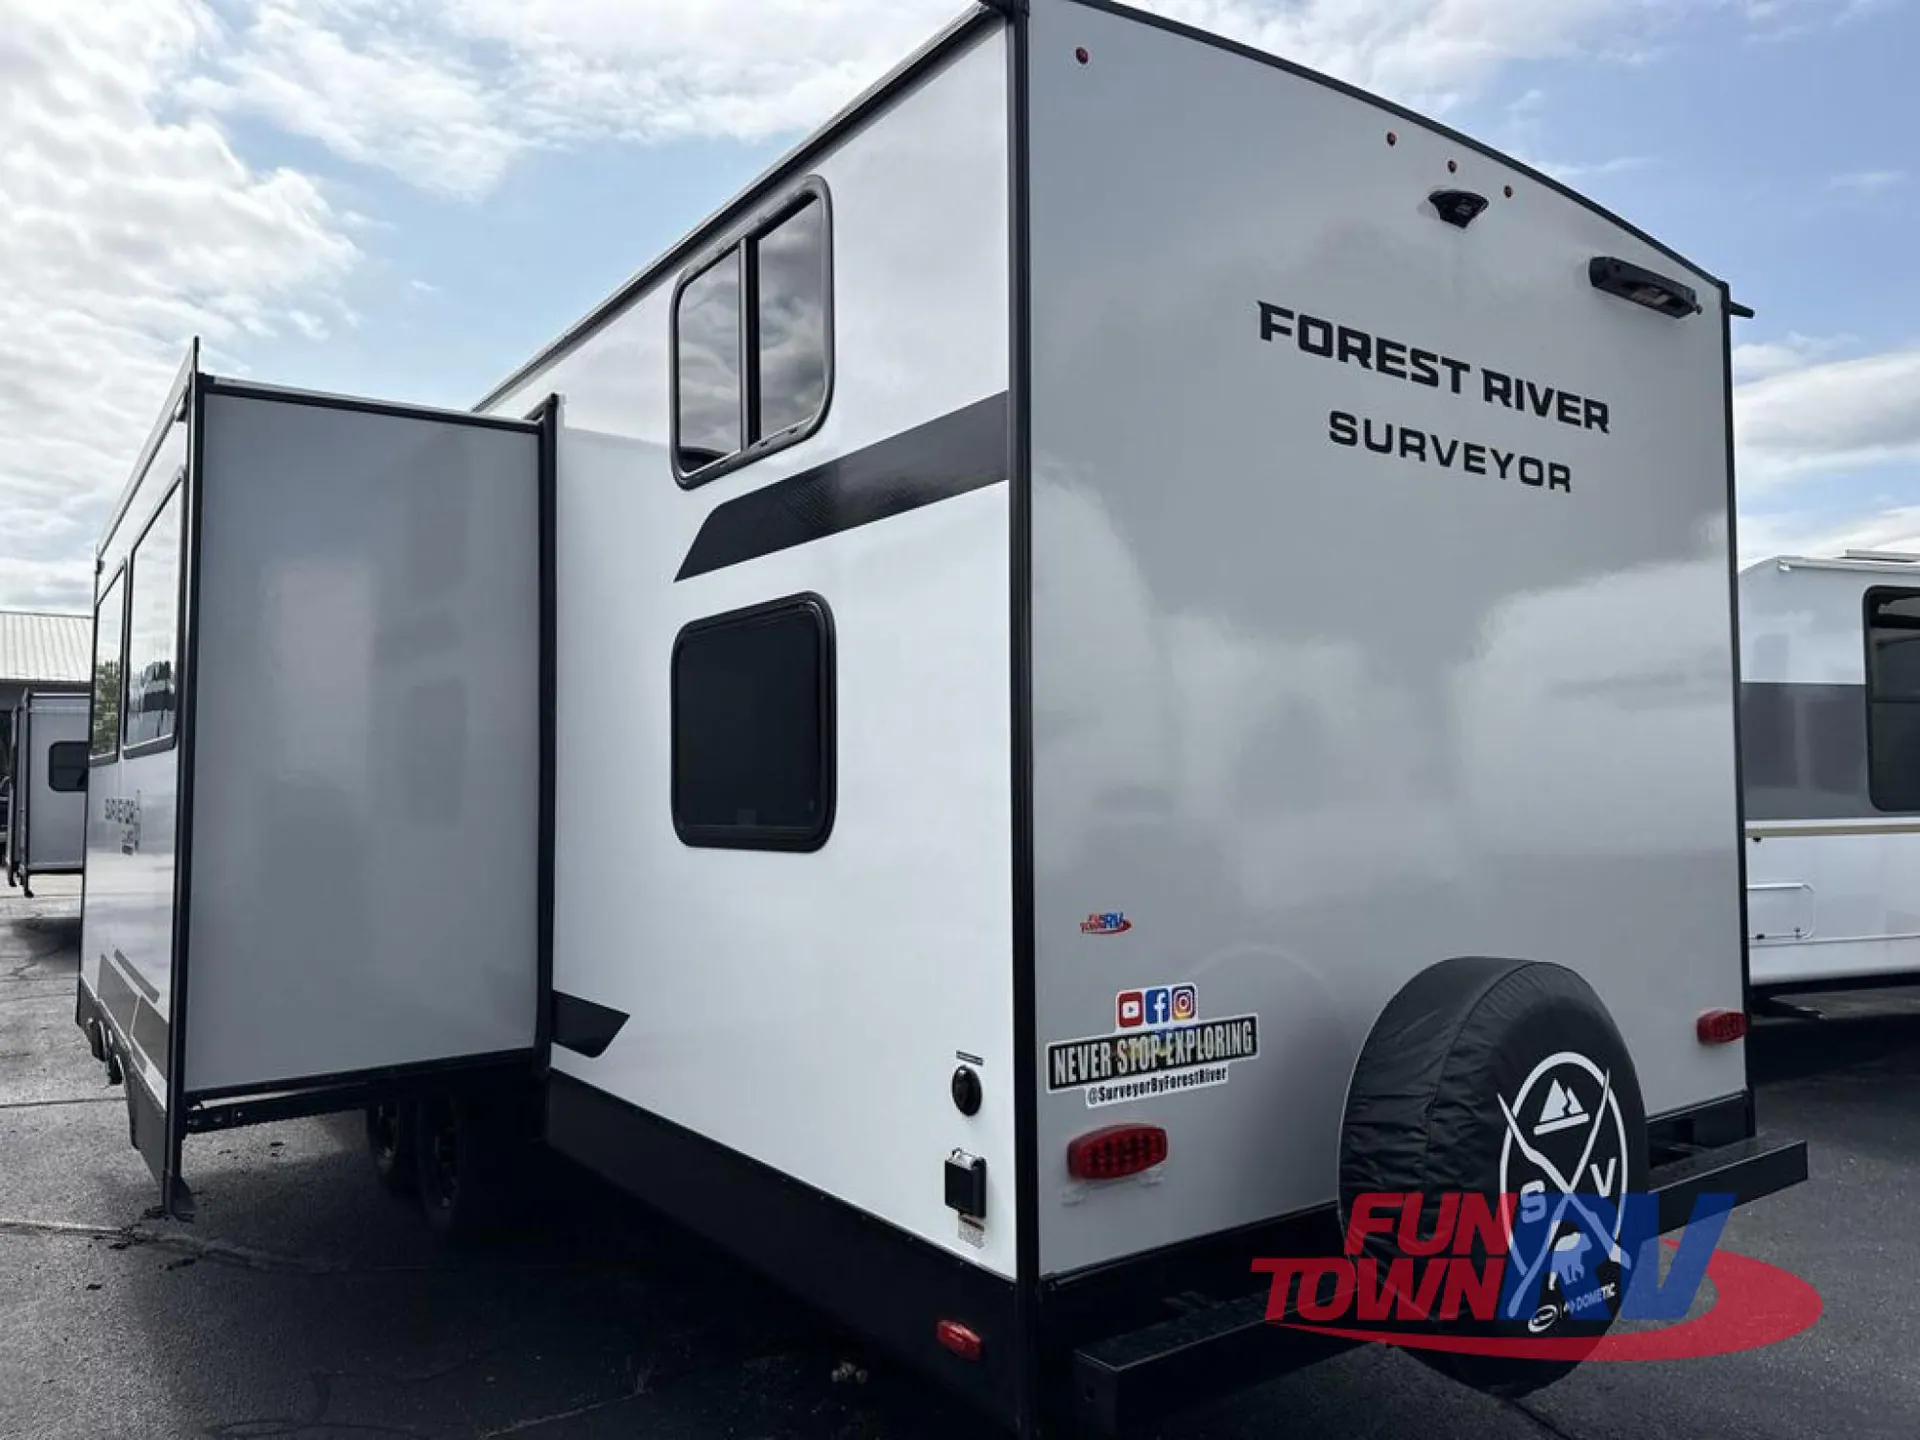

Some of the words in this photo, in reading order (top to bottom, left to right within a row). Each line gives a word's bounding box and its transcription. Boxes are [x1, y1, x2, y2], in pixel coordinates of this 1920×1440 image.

[1257, 300, 1471, 394] FOREST
[1481, 367, 1610, 434] RIVER
[1328, 410, 1571, 493] SURVEYOR
[1054, 1042, 1113, 1085] NEVER
[1117, 1034, 1160, 1074] STOP
[1166, 1020, 1252, 1066] EXPLORING
[1088, 1066, 1227, 1105] @SurveyorByForestRiver
[1576, 1282, 1616, 1311] DOMETIC
